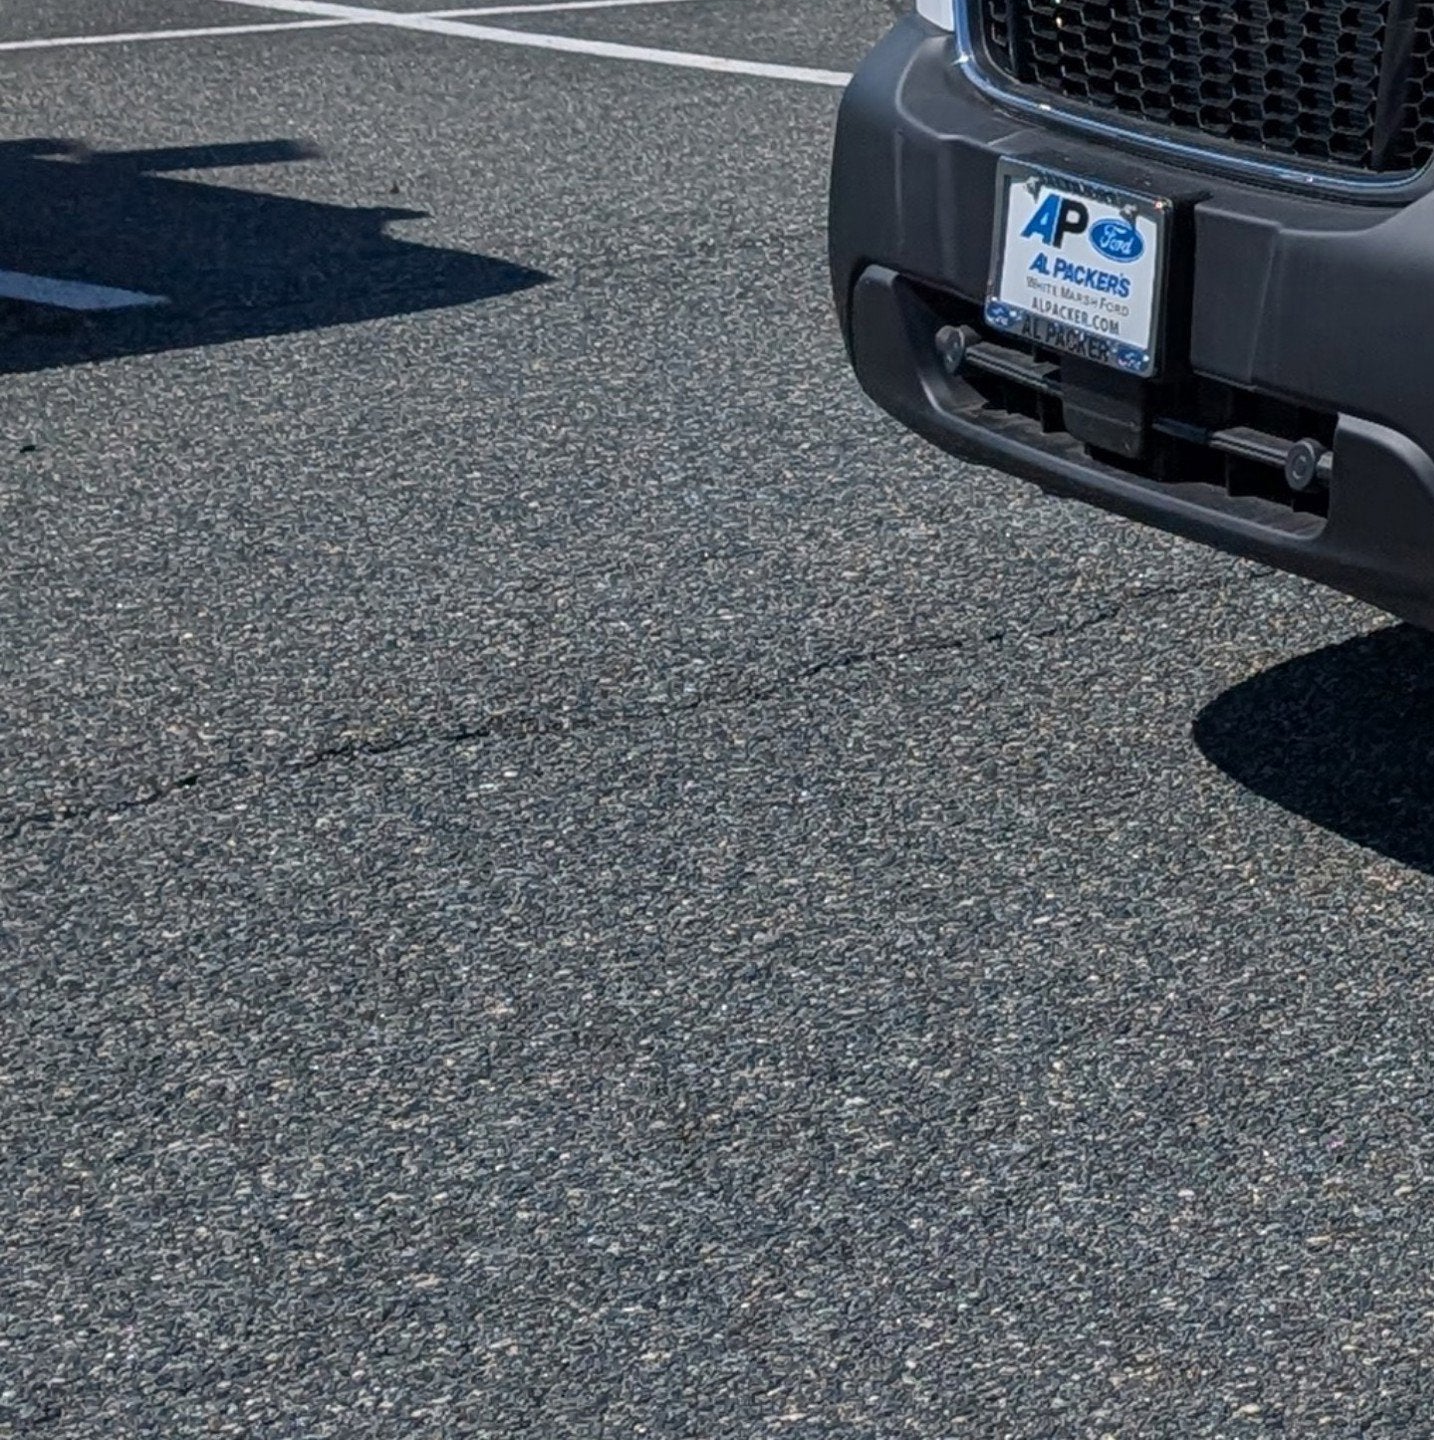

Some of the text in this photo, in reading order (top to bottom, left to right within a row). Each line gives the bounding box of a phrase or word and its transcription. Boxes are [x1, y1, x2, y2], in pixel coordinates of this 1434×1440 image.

[1020, 193, 1090, 249] AP
[1099, 222, 1133, 255] Ford
[1029, 252, 1131, 298] AL PACKER'S
[1021, 314, 1042, 340] AL
[1045, 321, 1110, 363] PACKER
[1032, 297, 1120, 336] ALPACKER.COM
